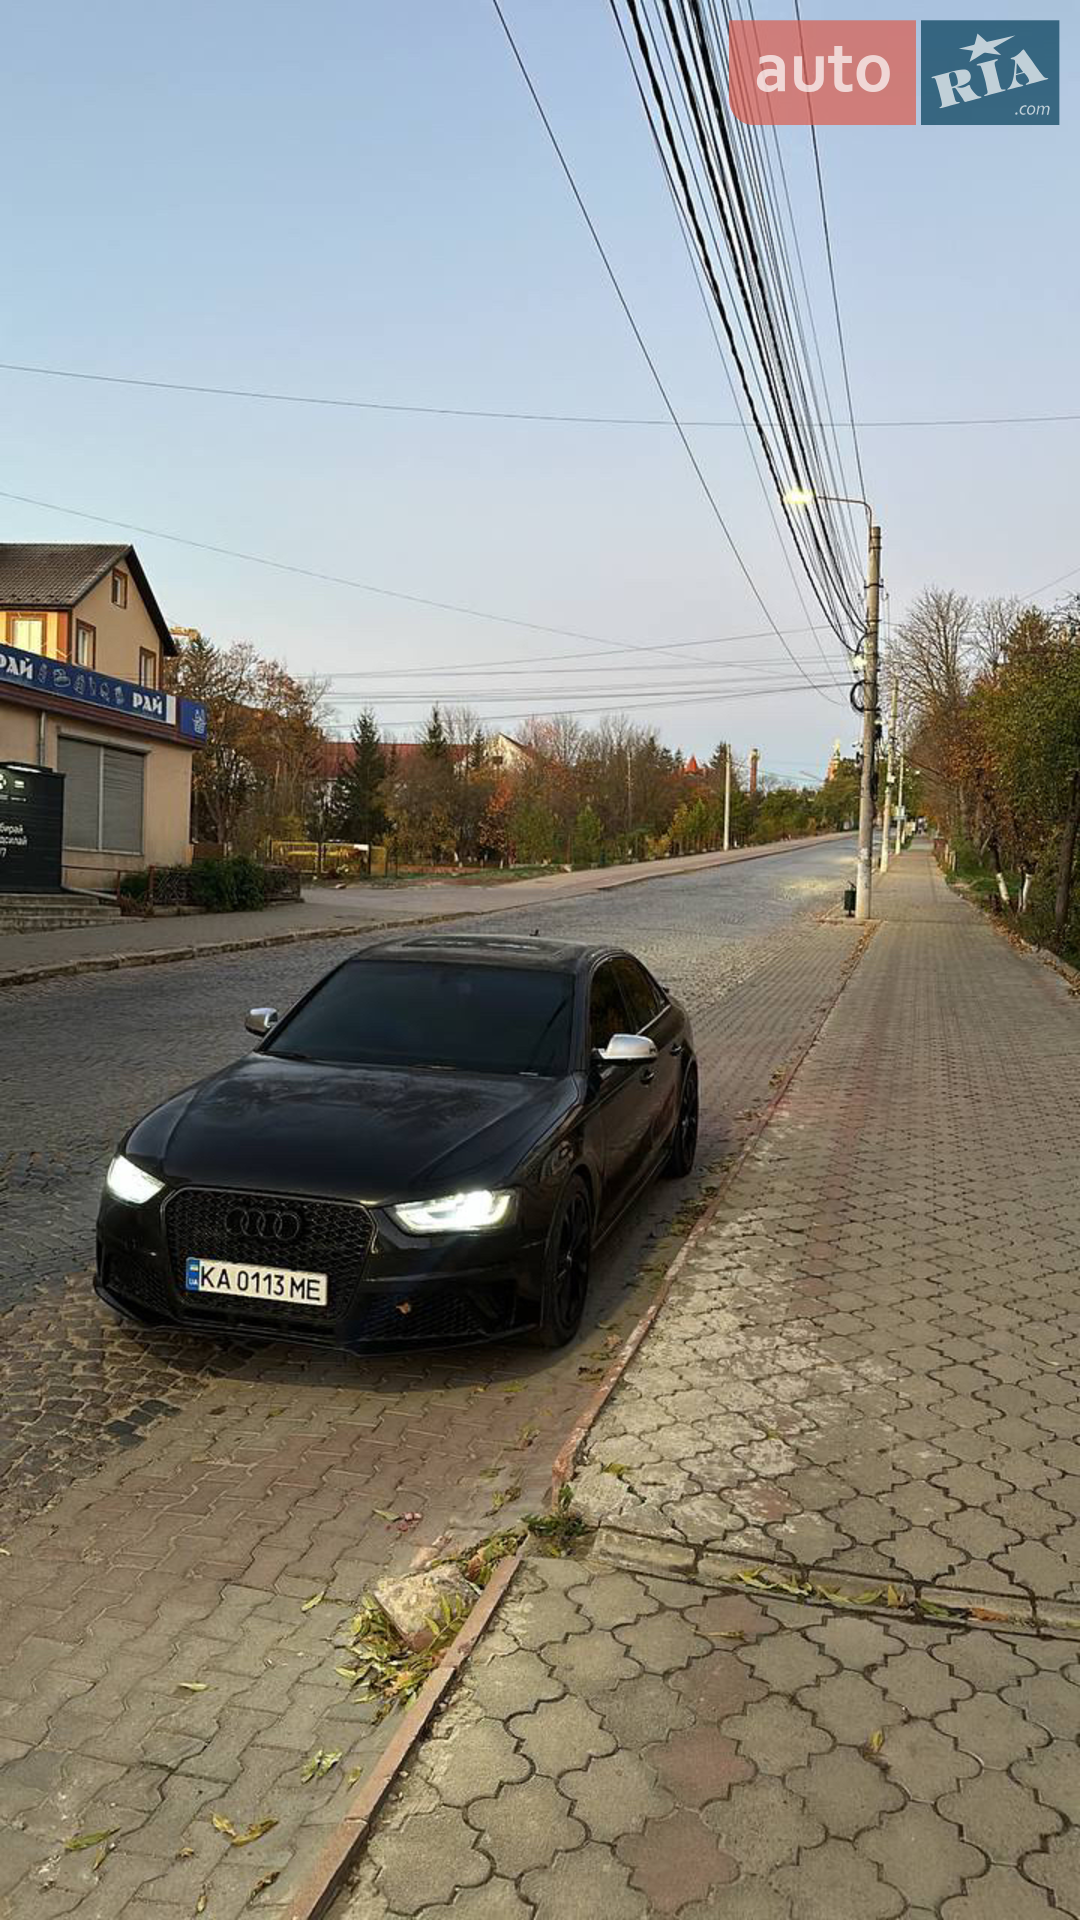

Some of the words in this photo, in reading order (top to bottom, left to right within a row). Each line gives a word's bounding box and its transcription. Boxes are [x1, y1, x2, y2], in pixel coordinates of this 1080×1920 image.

[133, 692, 163, 715] РАЙ
[200, 1265, 231, 1290] KA
[237, 1270, 284, 1296] 0113
[290, 1276, 320, 1301] ME
